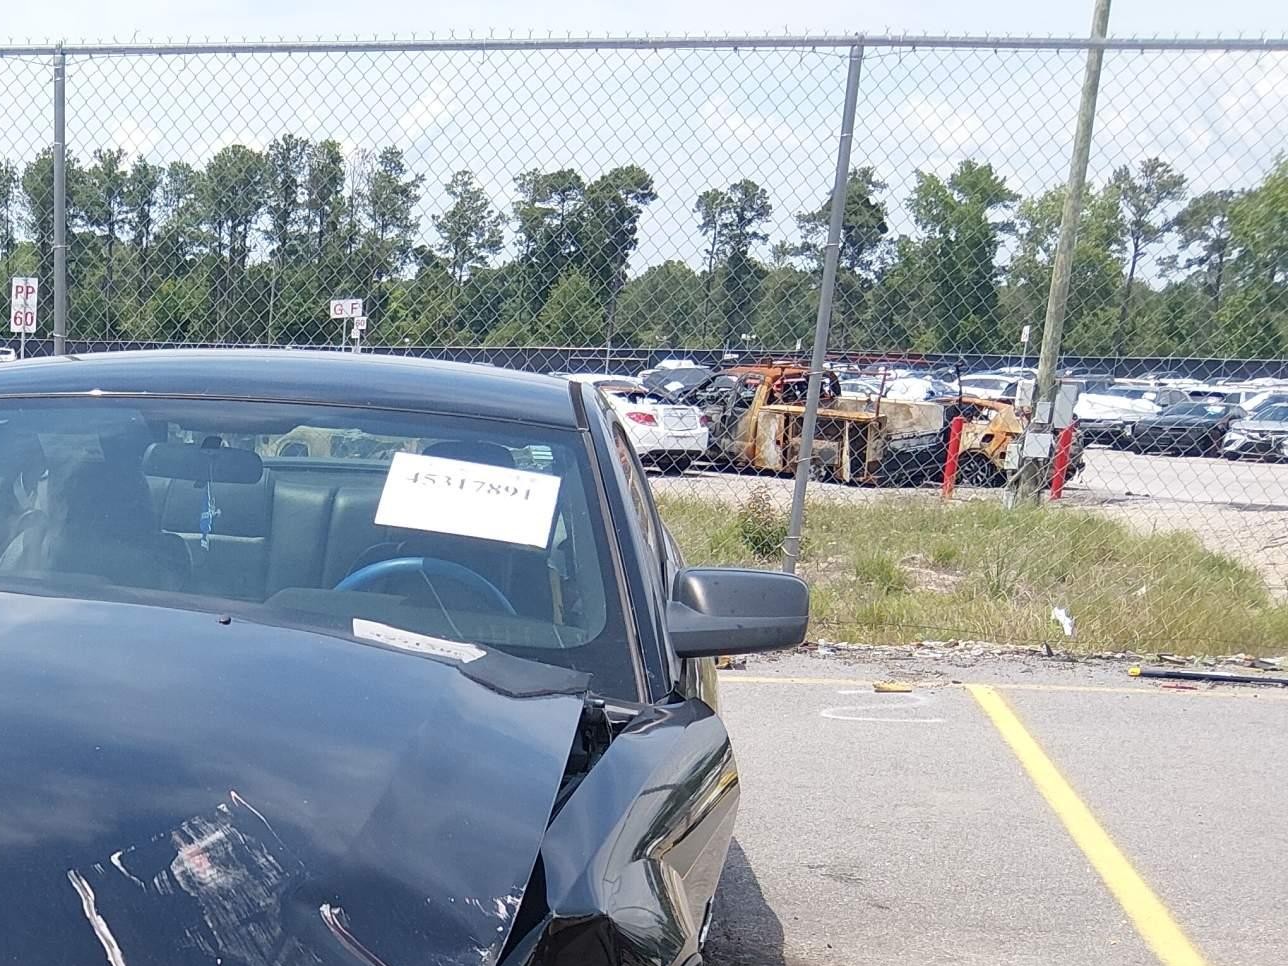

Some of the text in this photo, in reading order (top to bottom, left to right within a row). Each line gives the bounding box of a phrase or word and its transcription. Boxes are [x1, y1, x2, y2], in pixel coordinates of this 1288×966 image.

[15, 285, 35, 300] PP
[333, 303, 359, 315] G F
[14, 311, 34, 327] 60
[407, 472, 531, 501] 45317891
